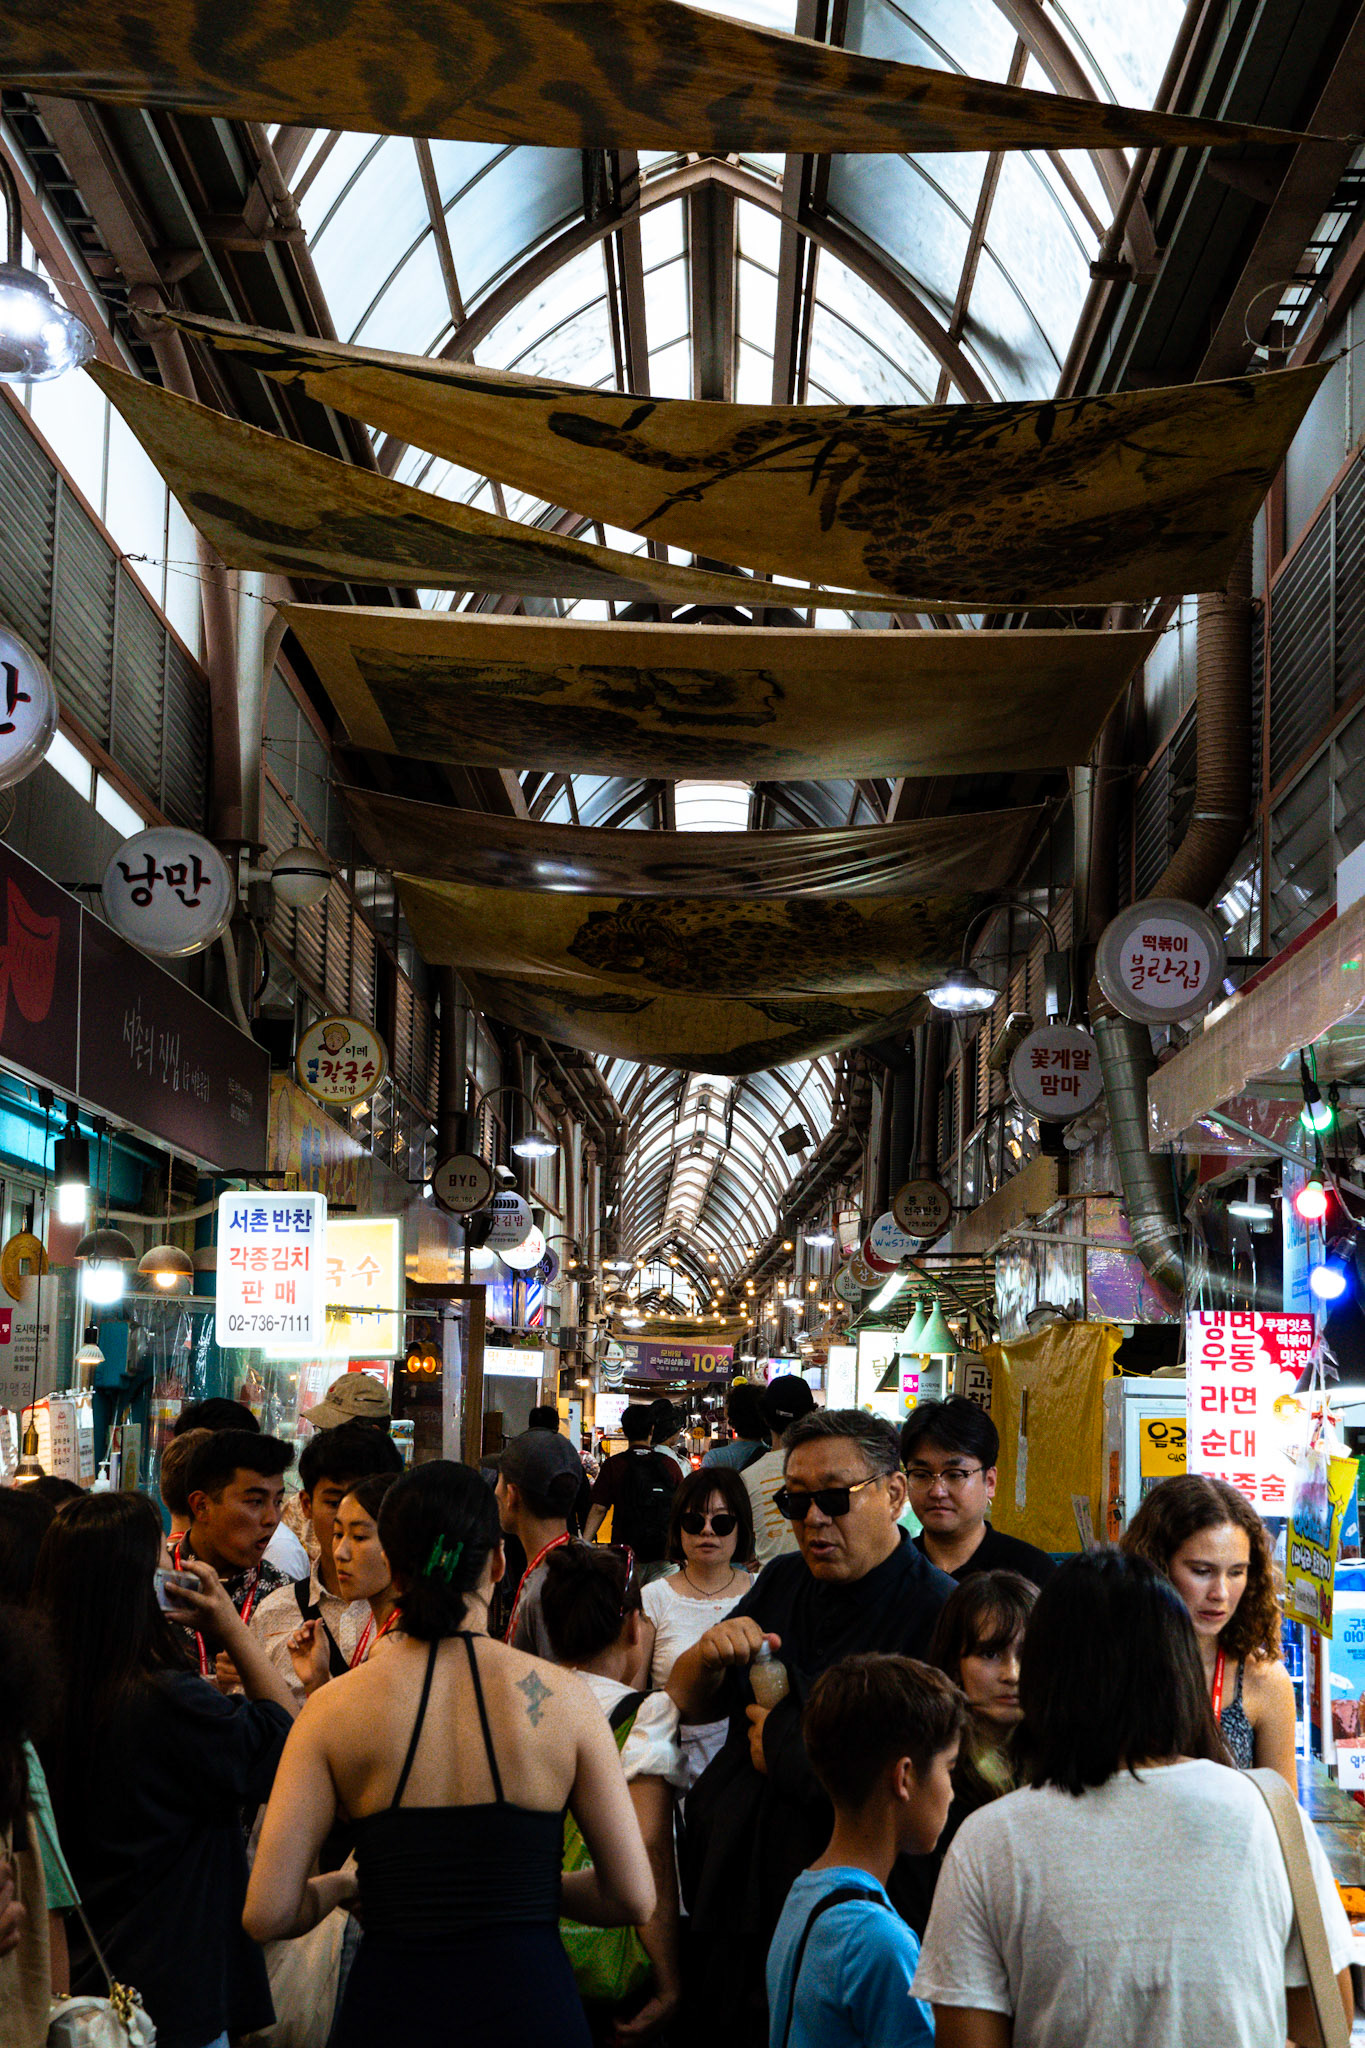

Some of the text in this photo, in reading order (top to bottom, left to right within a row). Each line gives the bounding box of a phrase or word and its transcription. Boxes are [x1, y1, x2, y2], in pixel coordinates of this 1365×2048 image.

[118, 853, 212, 908] 낭만
[1141, 935, 1188, 952] 떡볶이
[1130, 954, 1201, 990] 불란집
[345, 1045, 368, 1057] 이레
[1030, 1048, 1092, 1071] 꽃게알
[321, 1060, 376, 1083] 칼국수
[1040, 1074, 1082, 1097] 맘마
[449, 1174, 478, 1187] BYC
[228, 1208, 313, 1234] 서촌 반찬
[904, 1206, 942, 1216] 전주반찬
[229, 1246, 310, 1271] 각종김치
[228, 1314, 310, 1332] 02-736-7111
[1200, 1311, 1256, 1341] 냉면
[1264, 1318, 1312, 1333] 쿠팡잇츠
[1200, 1343, 1256, 1373] 우동
[1200, 1386, 1257, 1415] 라면
[1200, 1429, 1256, 1457] 순대
